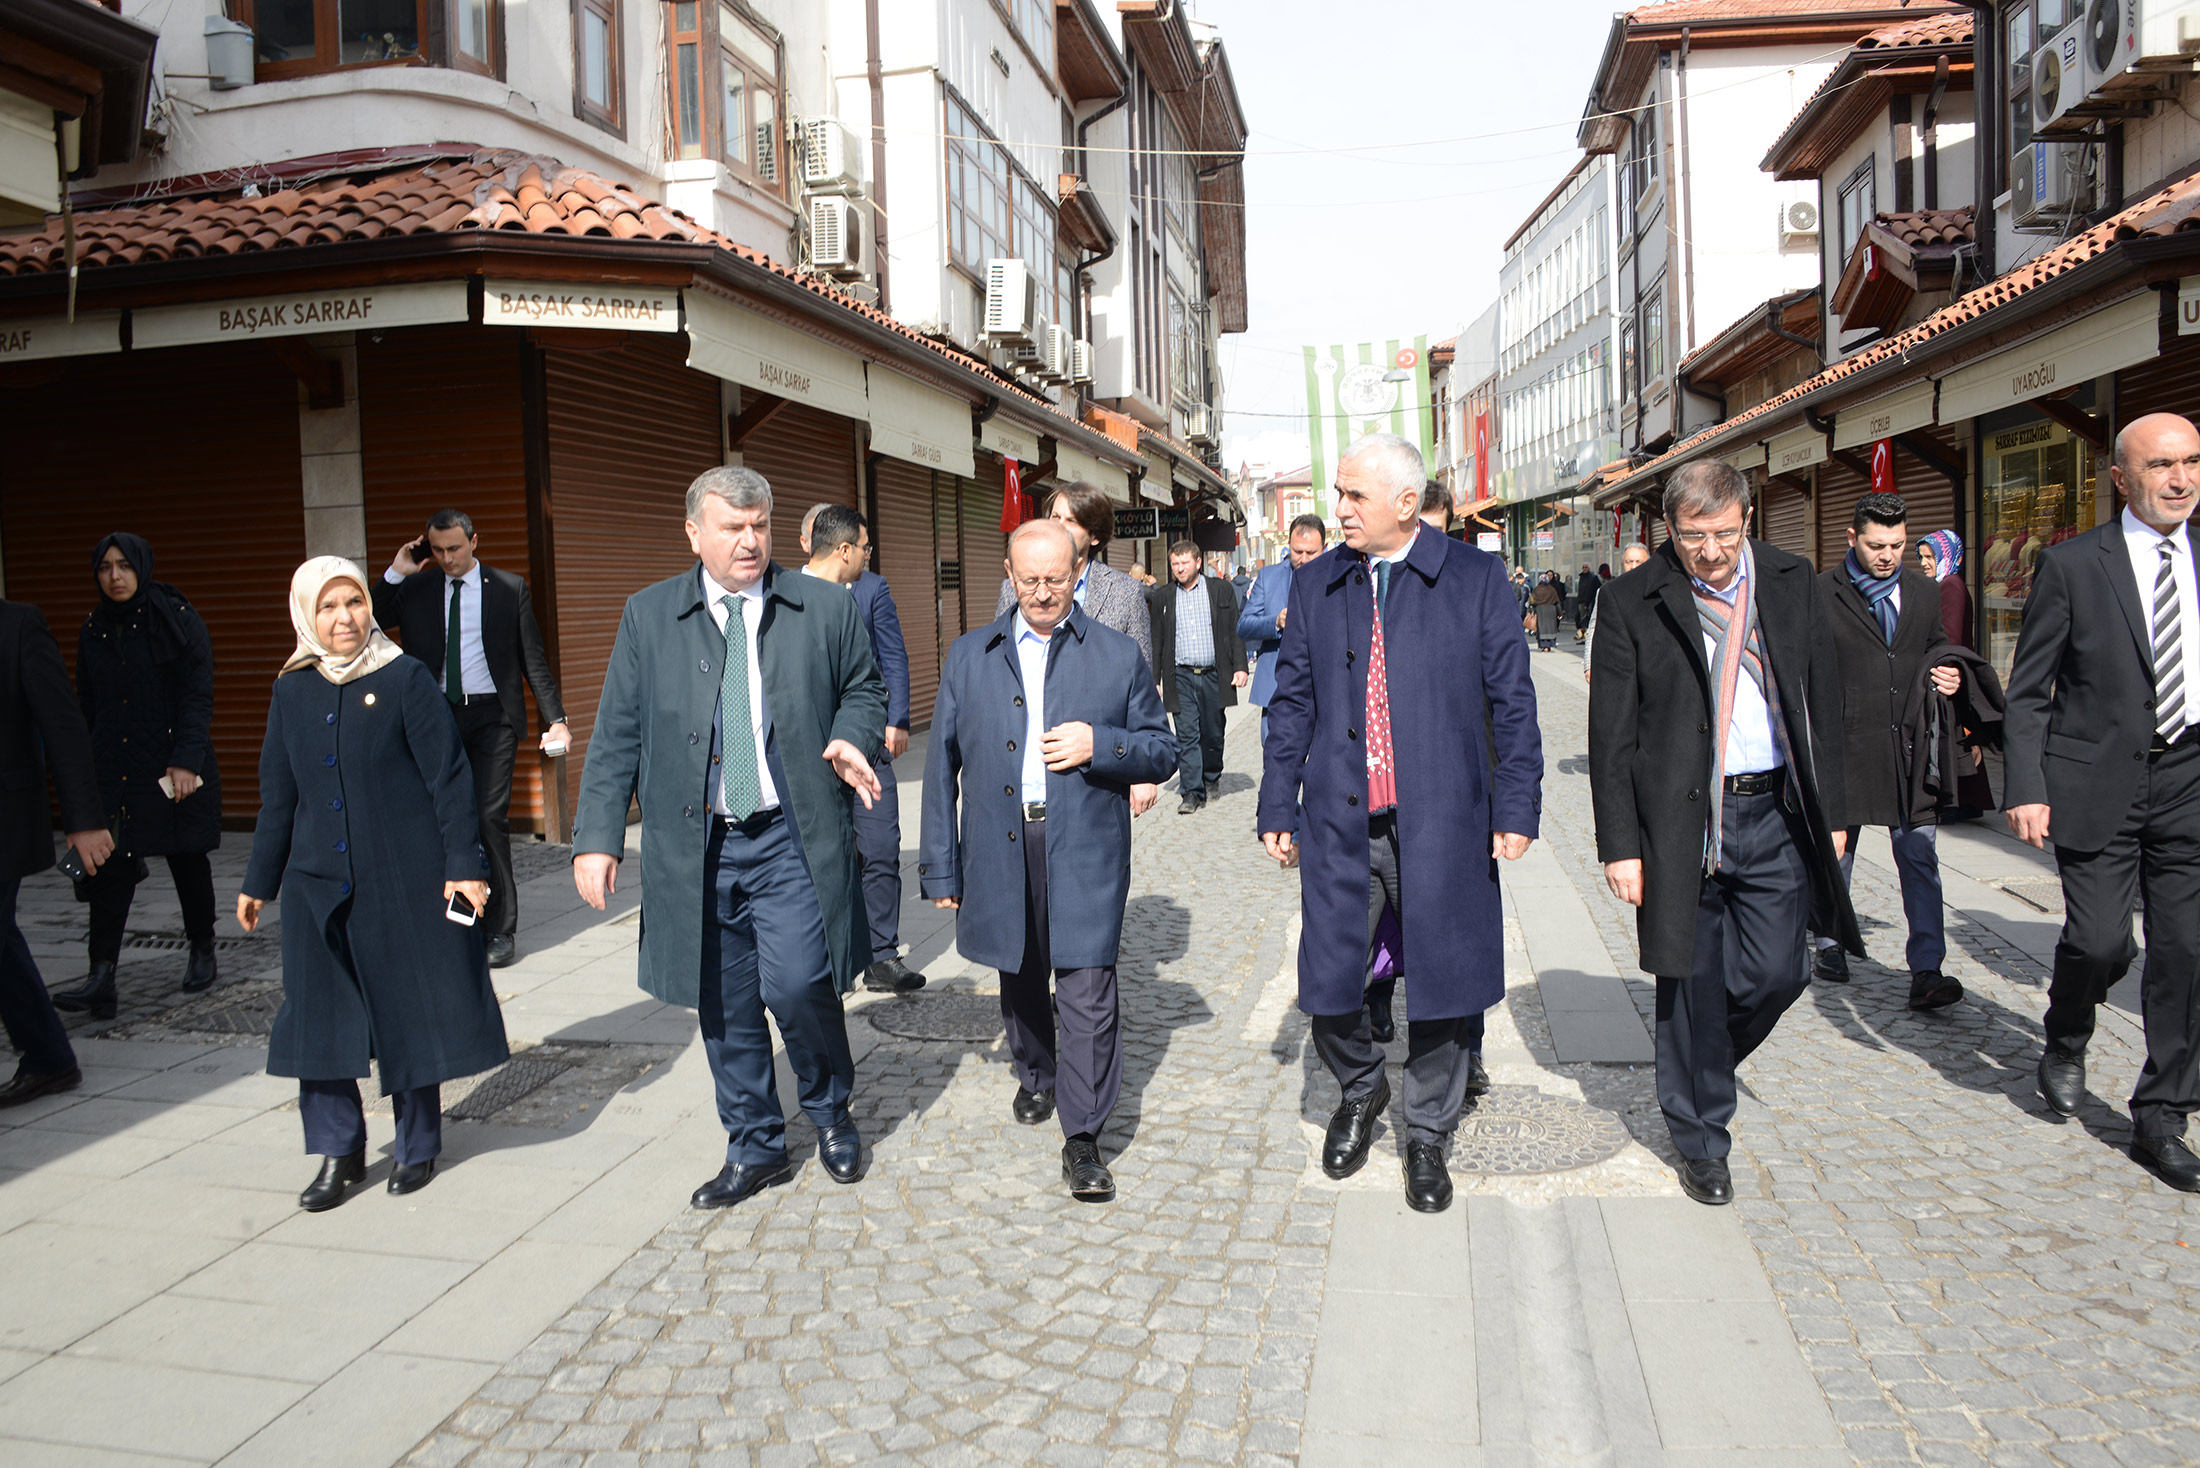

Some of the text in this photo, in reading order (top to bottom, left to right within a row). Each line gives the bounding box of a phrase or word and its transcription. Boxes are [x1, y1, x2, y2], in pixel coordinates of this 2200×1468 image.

[219, 297, 372, 333] BAŞAK SARRAF
[500, 293, 663, 320] BAŞAK SARRAF
[759, 361, 811, 394] BAŞAK SARRAF
[2012, 362, 2056, 396] UYAROĞLU
[1994, 432, 2018, 450] SARRAF
